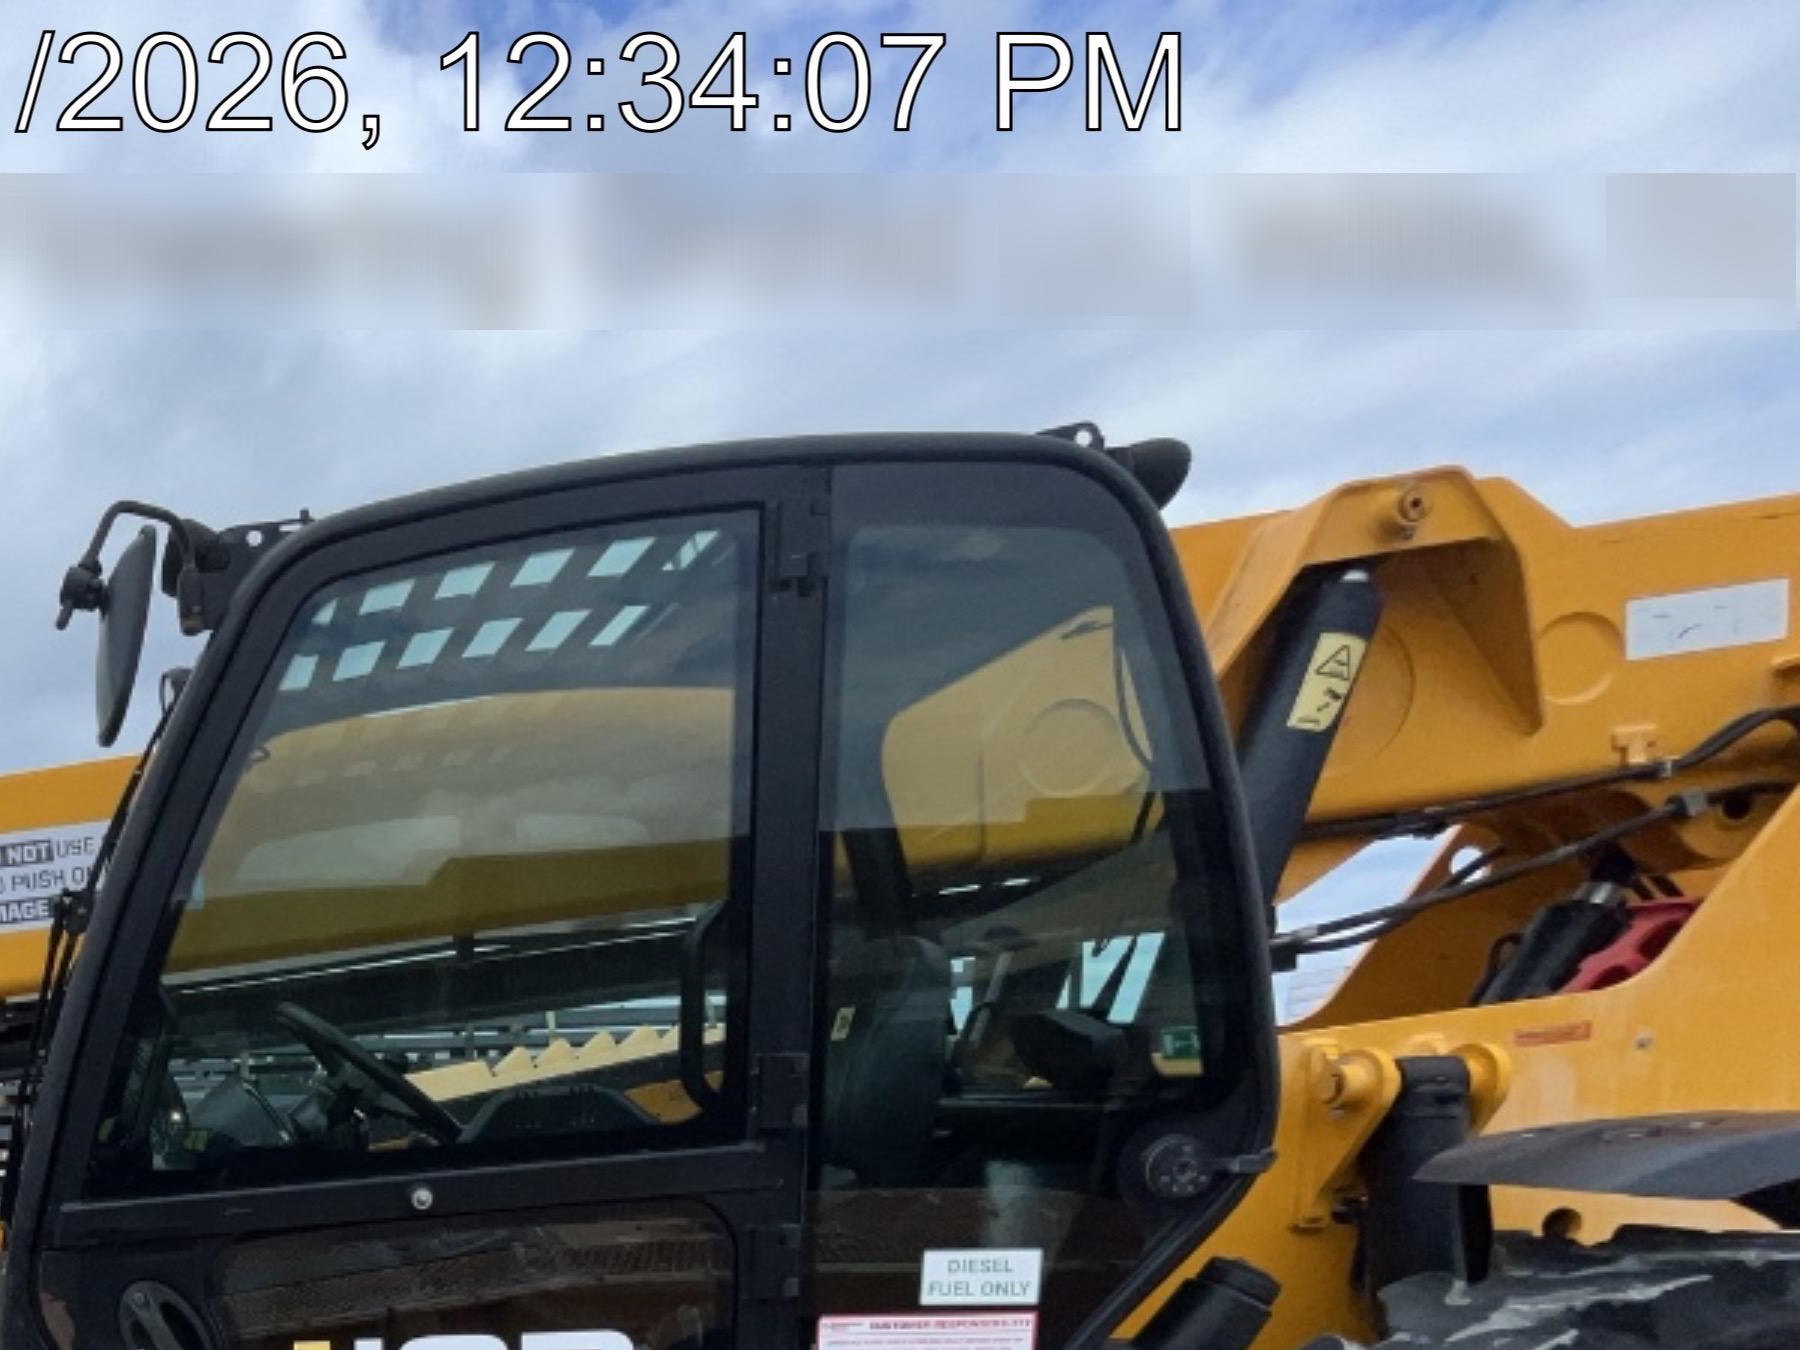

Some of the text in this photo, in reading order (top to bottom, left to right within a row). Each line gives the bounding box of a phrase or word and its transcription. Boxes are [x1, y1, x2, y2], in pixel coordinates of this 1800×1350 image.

[6, 842, 50, 866] NOT
[56, 836, 95, 858] USE
[11, 868, 65, 892] PUSH
[71, 866, 93, 887] O
[947, 1258, 1015, 1274] DIESEL
[927, 1280, 1031, 1297] FUEL ONLY
